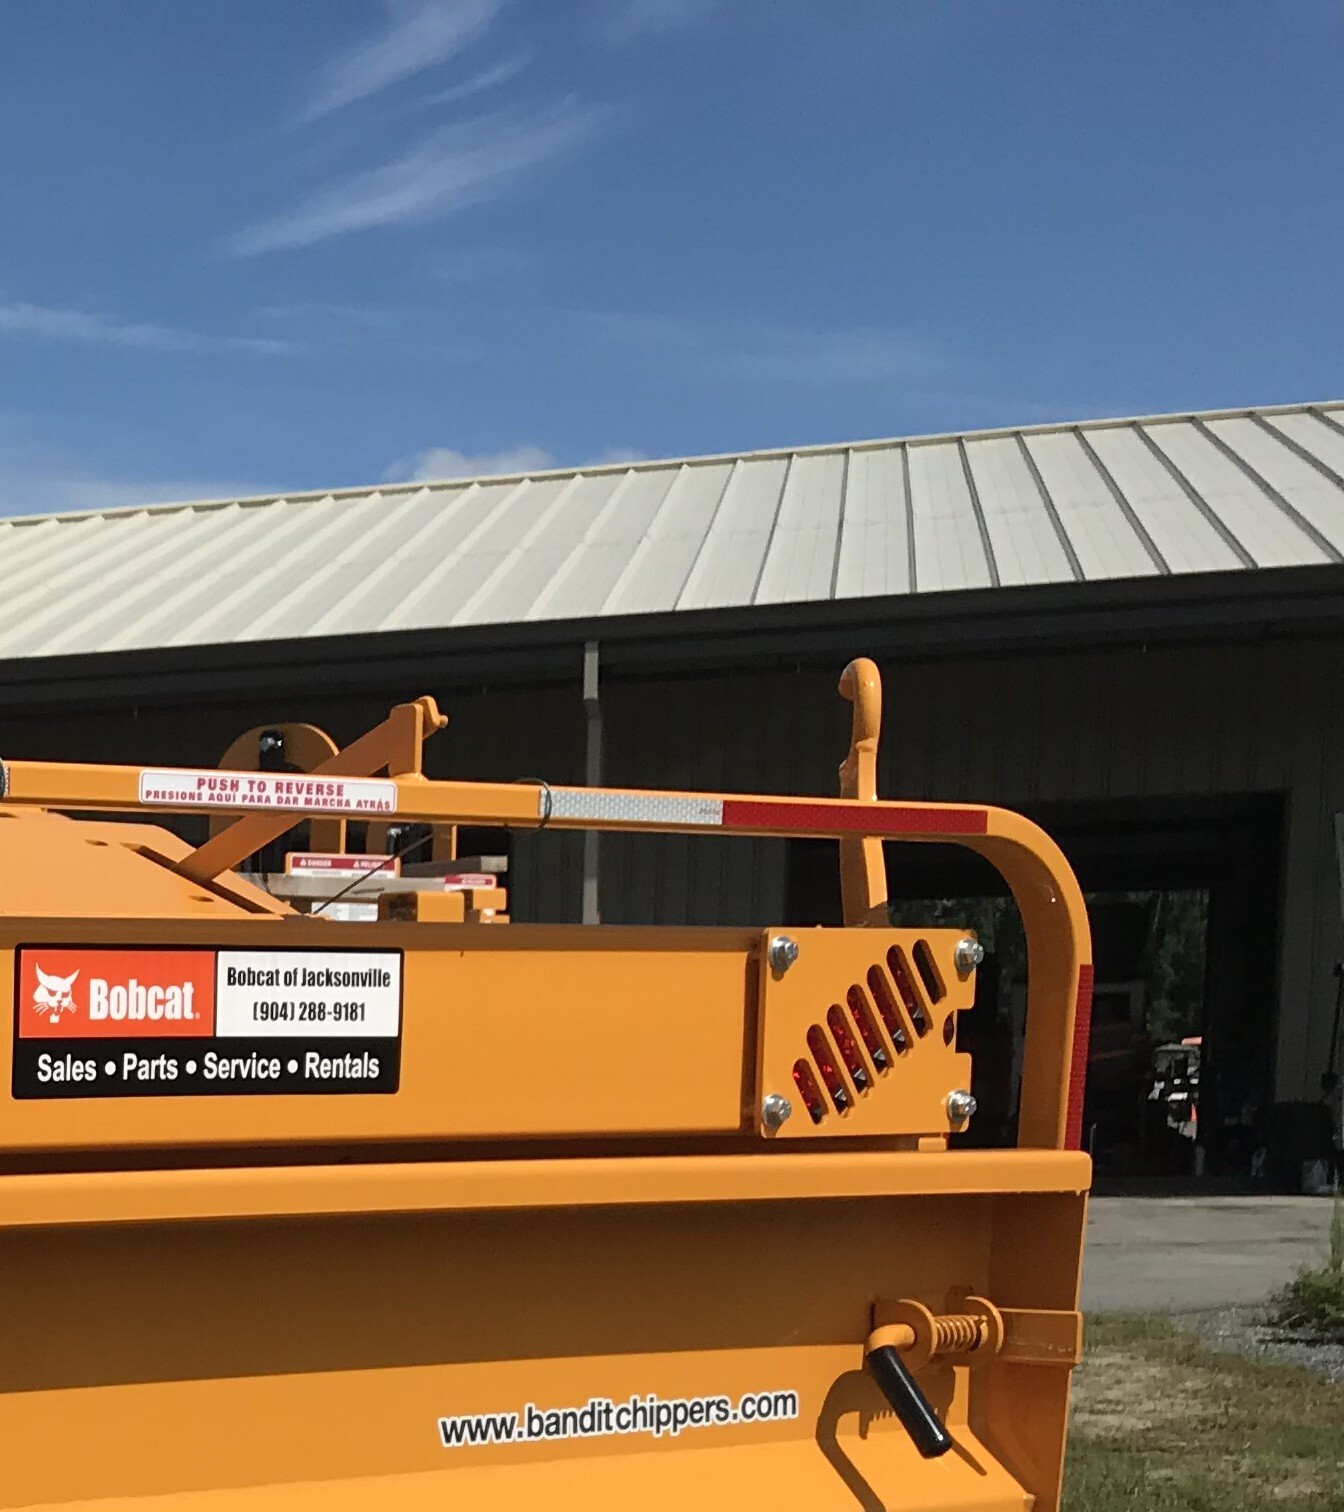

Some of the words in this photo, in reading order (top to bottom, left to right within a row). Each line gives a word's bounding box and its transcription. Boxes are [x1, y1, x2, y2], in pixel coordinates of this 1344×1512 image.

[196, 777, 239, 793] PUSH
[248, 779, 267, 793] TO
[275, 781, 345, 797] REVERSE
[145, 790, 203, 802] PRESIONE
[208, 790, 236, 803] AQUÍ
[241, 793, 271, 805] PARA
[276, 795, 299, 806] DAR
[304, 796, 351, 808] MARCHA
[356, 798, 391, 811] ATRÁS
[226, 966, 281, 988] Bobcat
[283, 966, 299, 987] of
[300, 966, 391, 988] Jacksonville
[89, 977, 194, 1021] Bobcat
[252, 1000, 296, 1023] (904)
[298, 1001, 366, 1023] 288-9181
[37, 1052, 97, 1083] Sales
[122, 1052, 179, 1081] Parts
[203, 1051, 282, 1080] Service
[304, 1051, 380, 1080] Rentals
[440, 1391, 797, 1444] www.banditchippers.com
